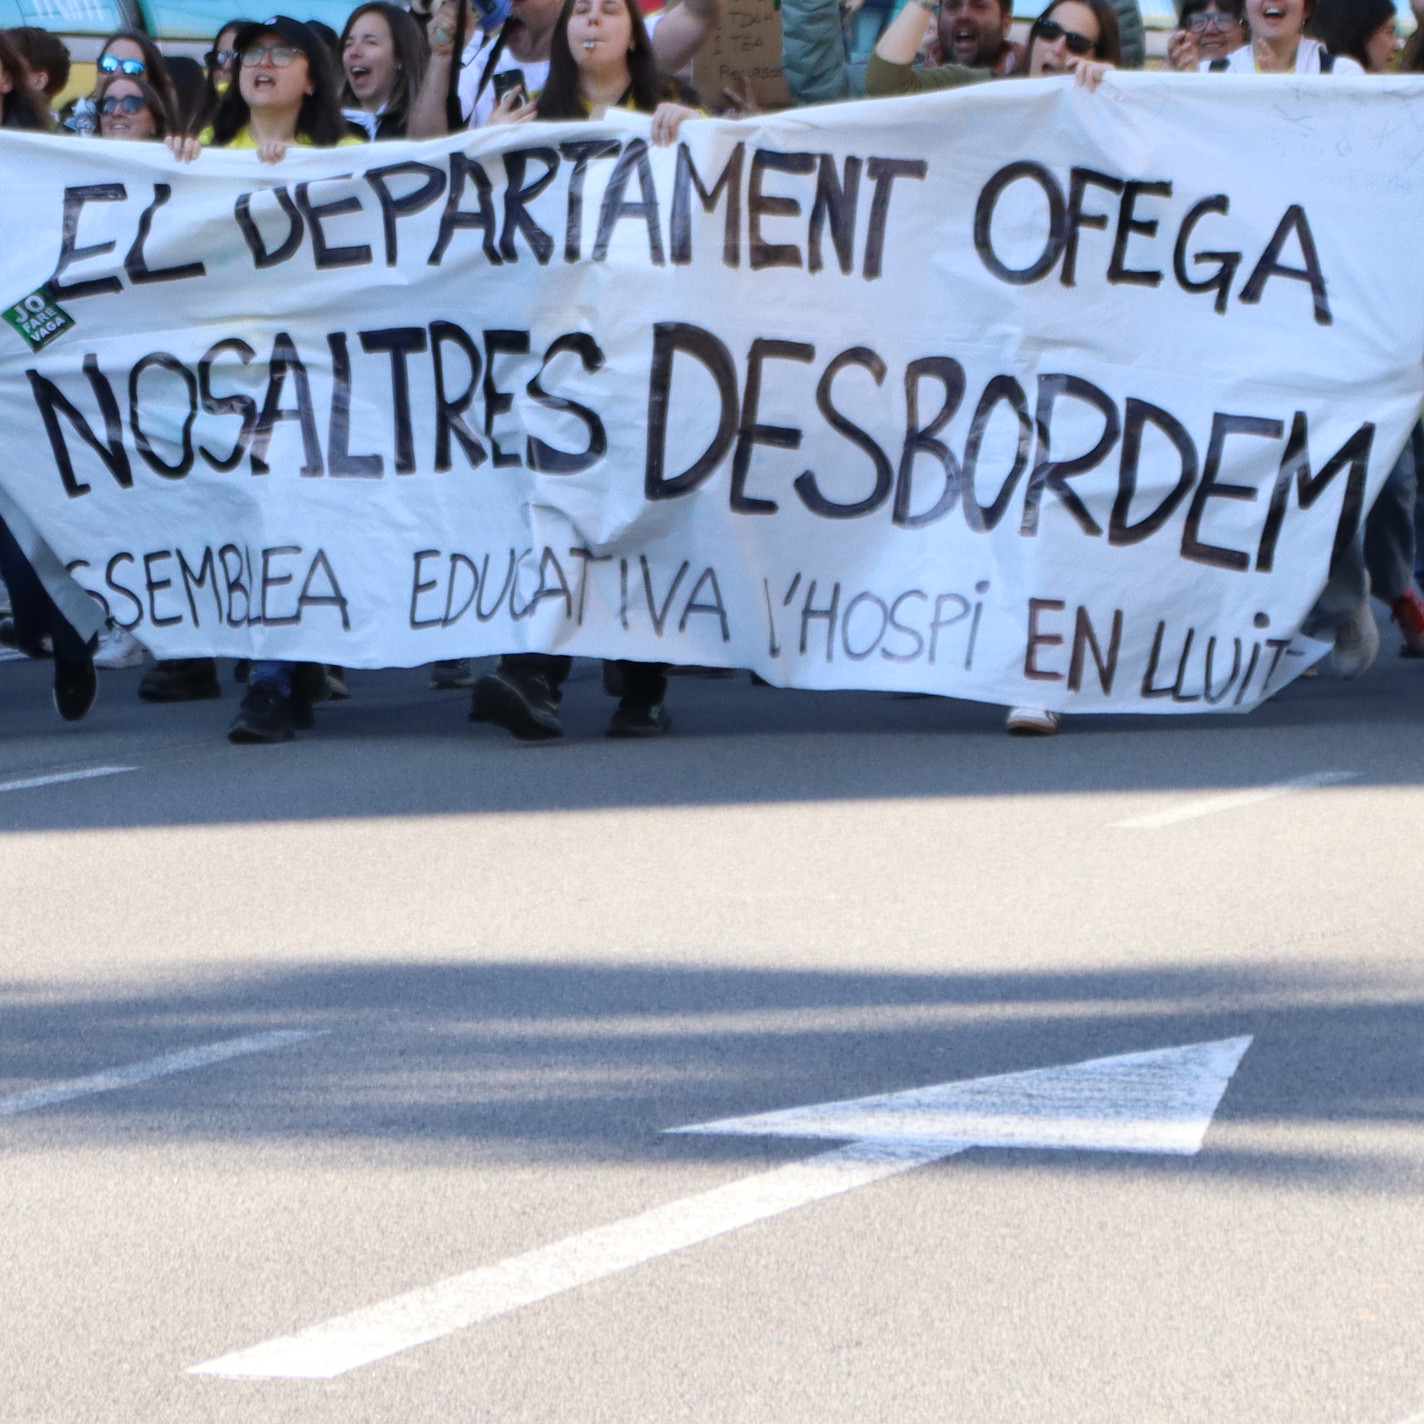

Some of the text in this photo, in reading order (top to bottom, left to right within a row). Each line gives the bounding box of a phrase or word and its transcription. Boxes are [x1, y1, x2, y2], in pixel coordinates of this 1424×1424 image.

[730, 35, 764, 53] TEA
[49, 138, 1333, 326] EL DEPARTAMENT OFEGA
[13, 294, 46, 324] JO
[31, 316, 66, 343] VAGA
[26, 320, 1376, 575] NOSALTRES DESBORDEM
[410, 546, 730, 643] EDUCATIVA
[1023, 598, 1124, 696] EN
